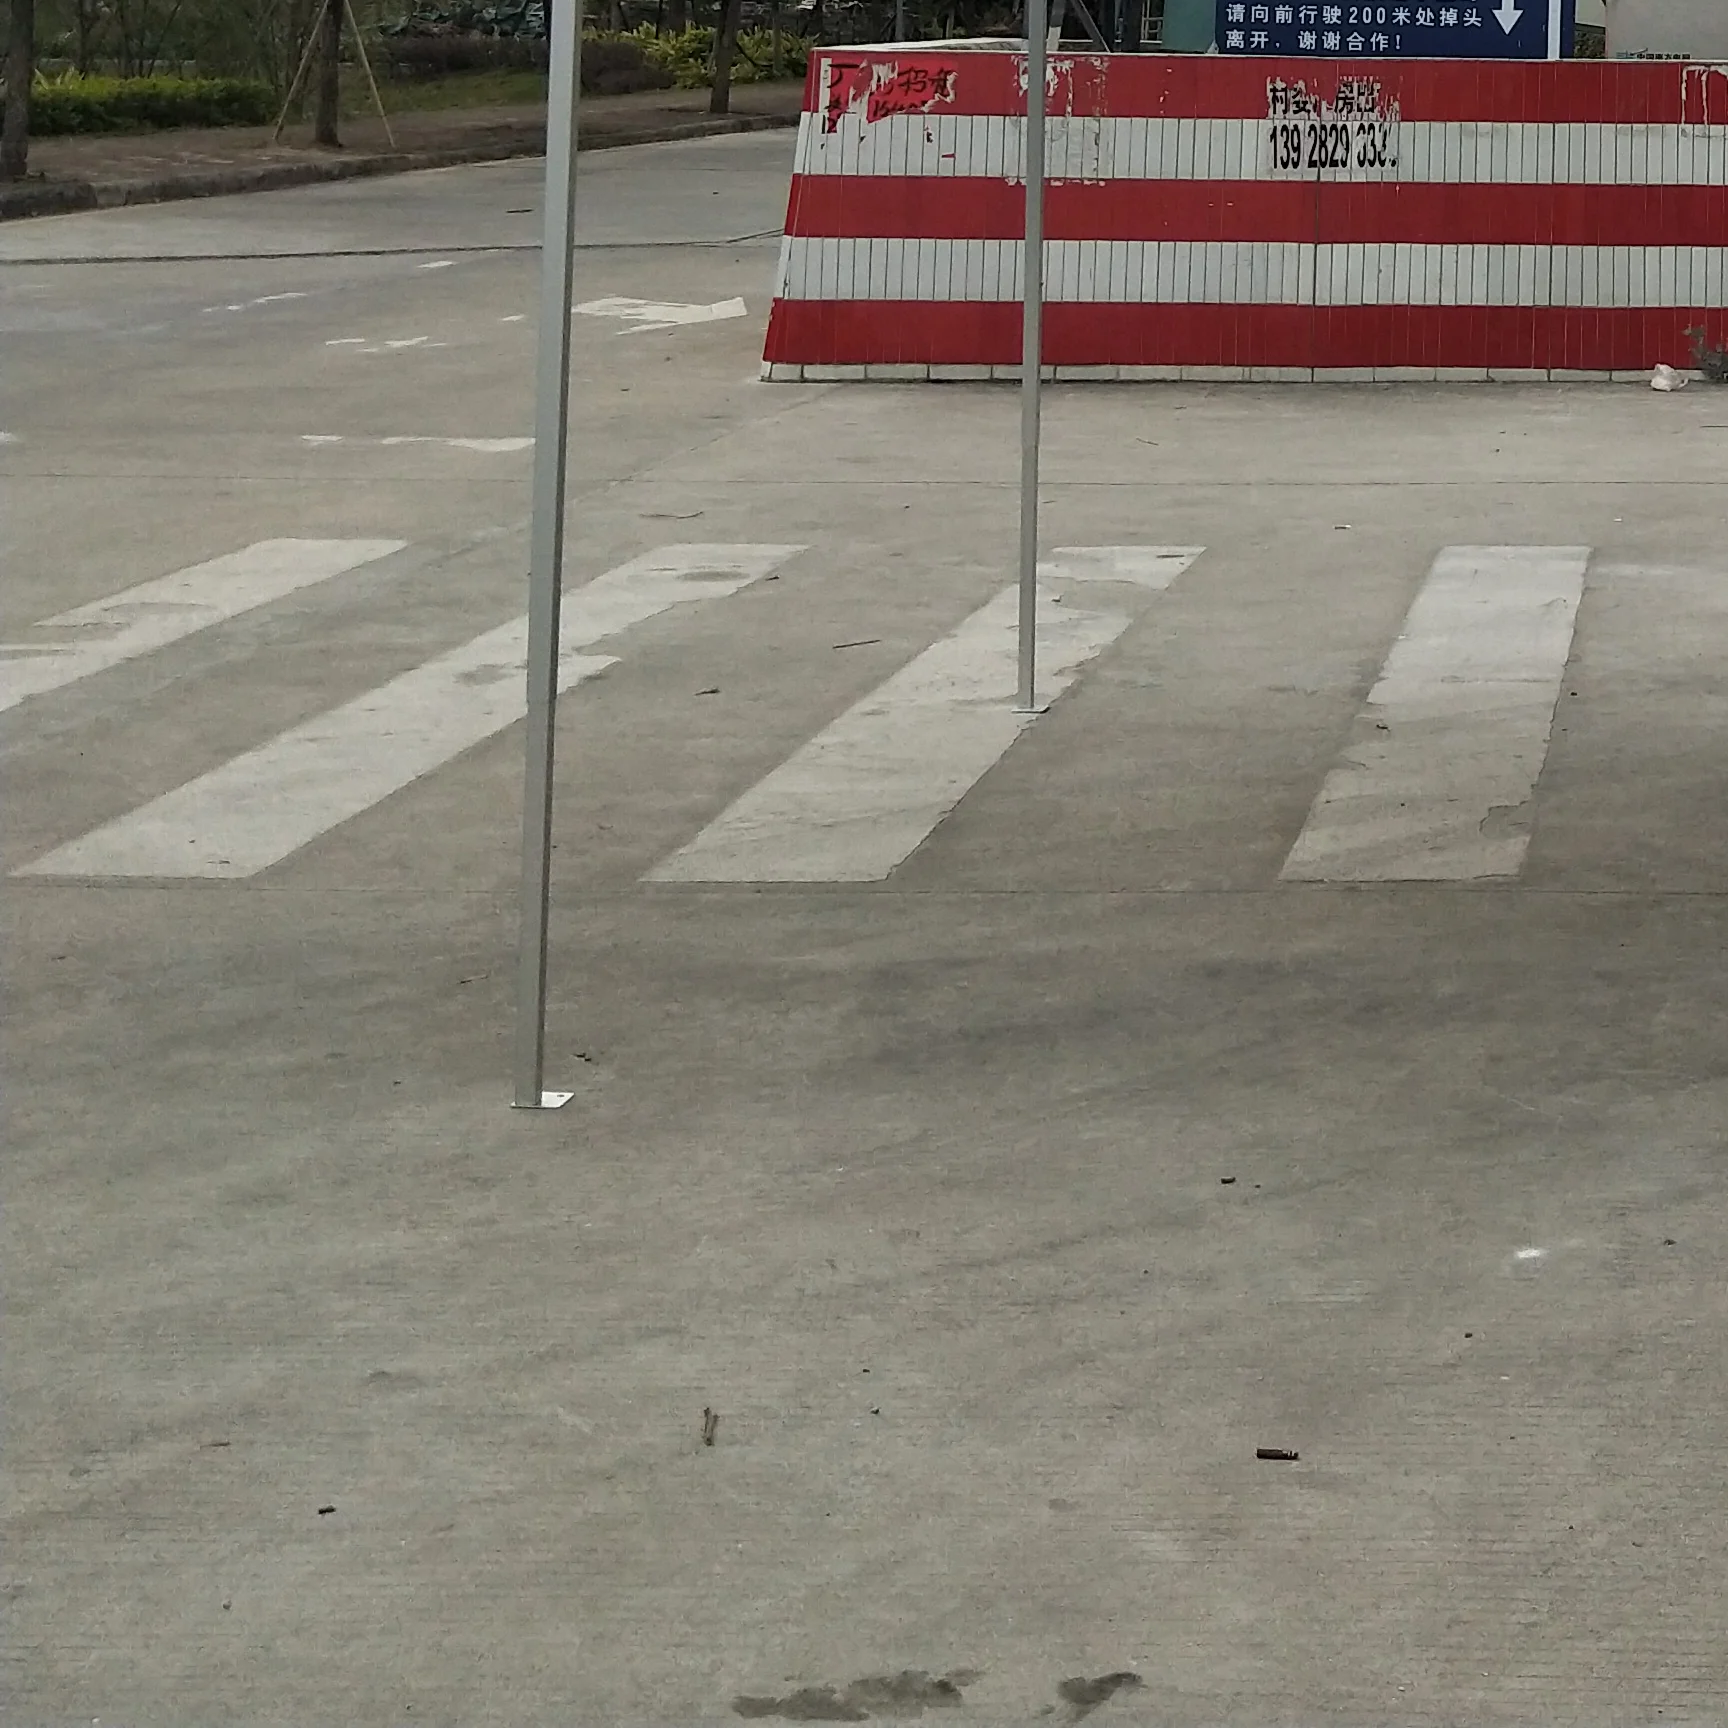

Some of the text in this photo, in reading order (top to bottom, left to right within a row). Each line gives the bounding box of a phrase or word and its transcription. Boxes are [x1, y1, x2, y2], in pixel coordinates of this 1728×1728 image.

[1225, 4, 1482, 28] 请向前行驶200米处掉头
[1225, 30, 1402, 52] 离开，谢谢合作！
[1270, 124, 1301, 169] 139
[1307, 124, 1350, 169] 2829
